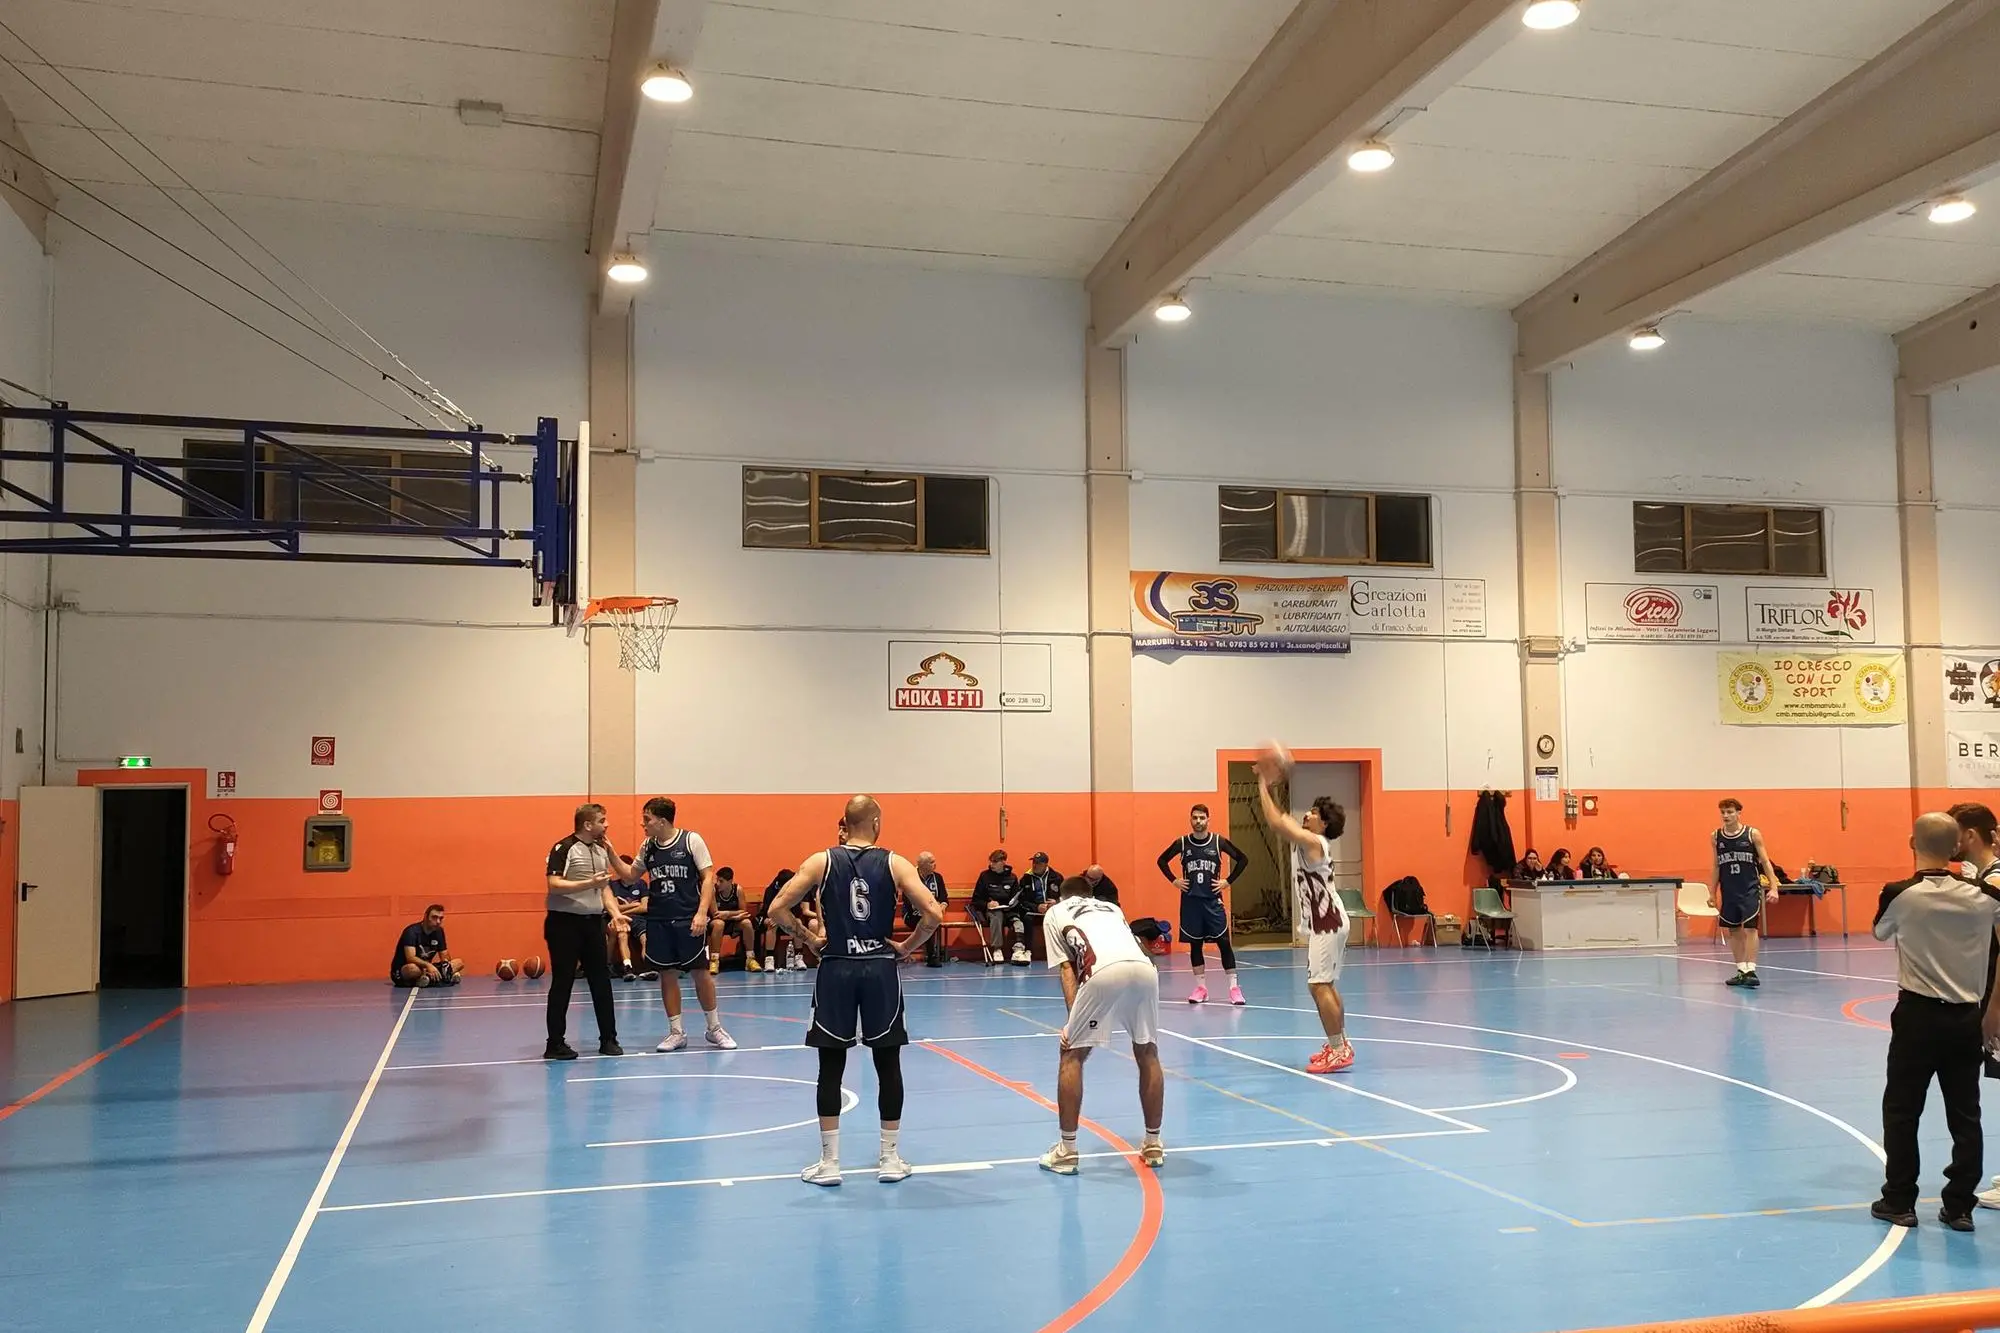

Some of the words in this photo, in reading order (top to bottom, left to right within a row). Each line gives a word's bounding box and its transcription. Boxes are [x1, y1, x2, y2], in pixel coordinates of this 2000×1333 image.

[1254, 584, 1294, 592] STAZIONE
[1307, 584, 1345, 593] SERVIZIO
[1350, 580, 1427, 605] Creazioni
[1190, 581, 1238, 611] 3S
[1281, 600, 1338, 608] CARBURANTI
[1350, 592, 1426, 617] Carlotta
[1282, 612, 1341, 620] LUBRIFICANTI
[1283, 624, 1347, 633] AUTOLAVAGGIO
[1135, 638, 1175, 646] MARRUBIU
[1774, 661, 1793, 671] IO
[1797, 661, 1852, 672] CRESCO
[1786, 673, 1815, 685] CON
[1820, 674, 1842, 685] LO
[898, 689, 940, 706] MOKA
[947, 690, 981, 707] EFTI
[1793, 687, 1836, 698] SPORT
[1730, 864, 1741, 875] 13
[1197, 872, 1204, 884] 8
[660, 880, 676, 893] 35
[849, 876, 871, 922] 6
